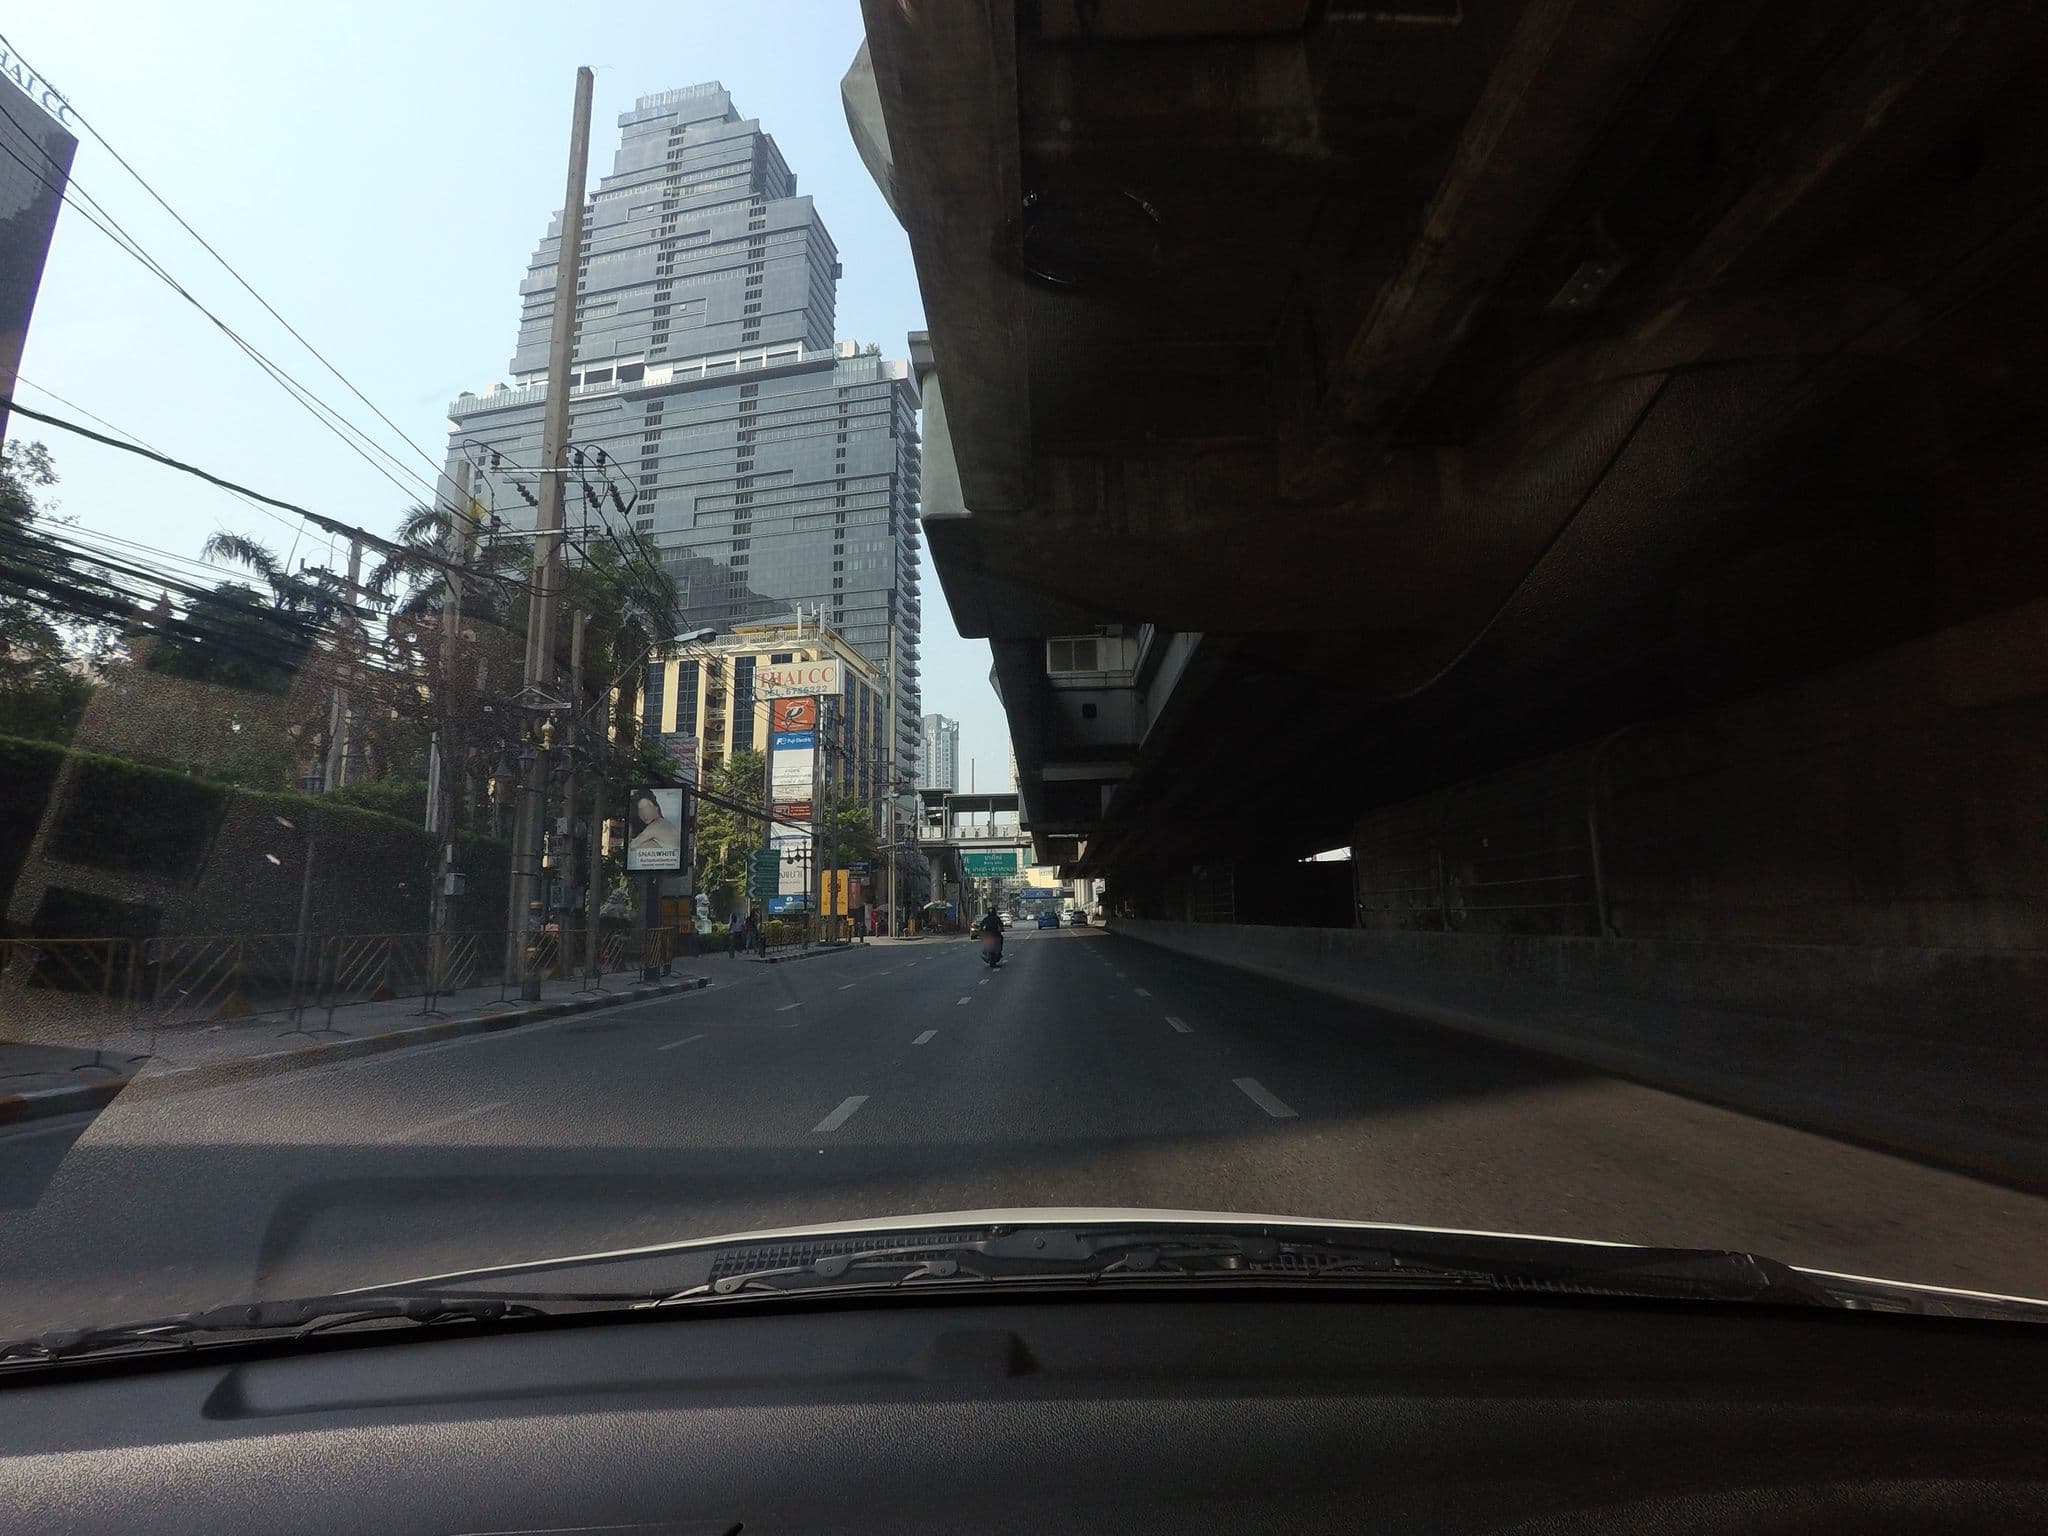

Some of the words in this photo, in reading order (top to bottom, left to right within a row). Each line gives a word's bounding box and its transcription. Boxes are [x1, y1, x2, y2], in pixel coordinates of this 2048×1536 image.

[42, 91, 72, 127] CC
[759, 669, 804, 688] THAI
[808, 667, 834, 684] CC
